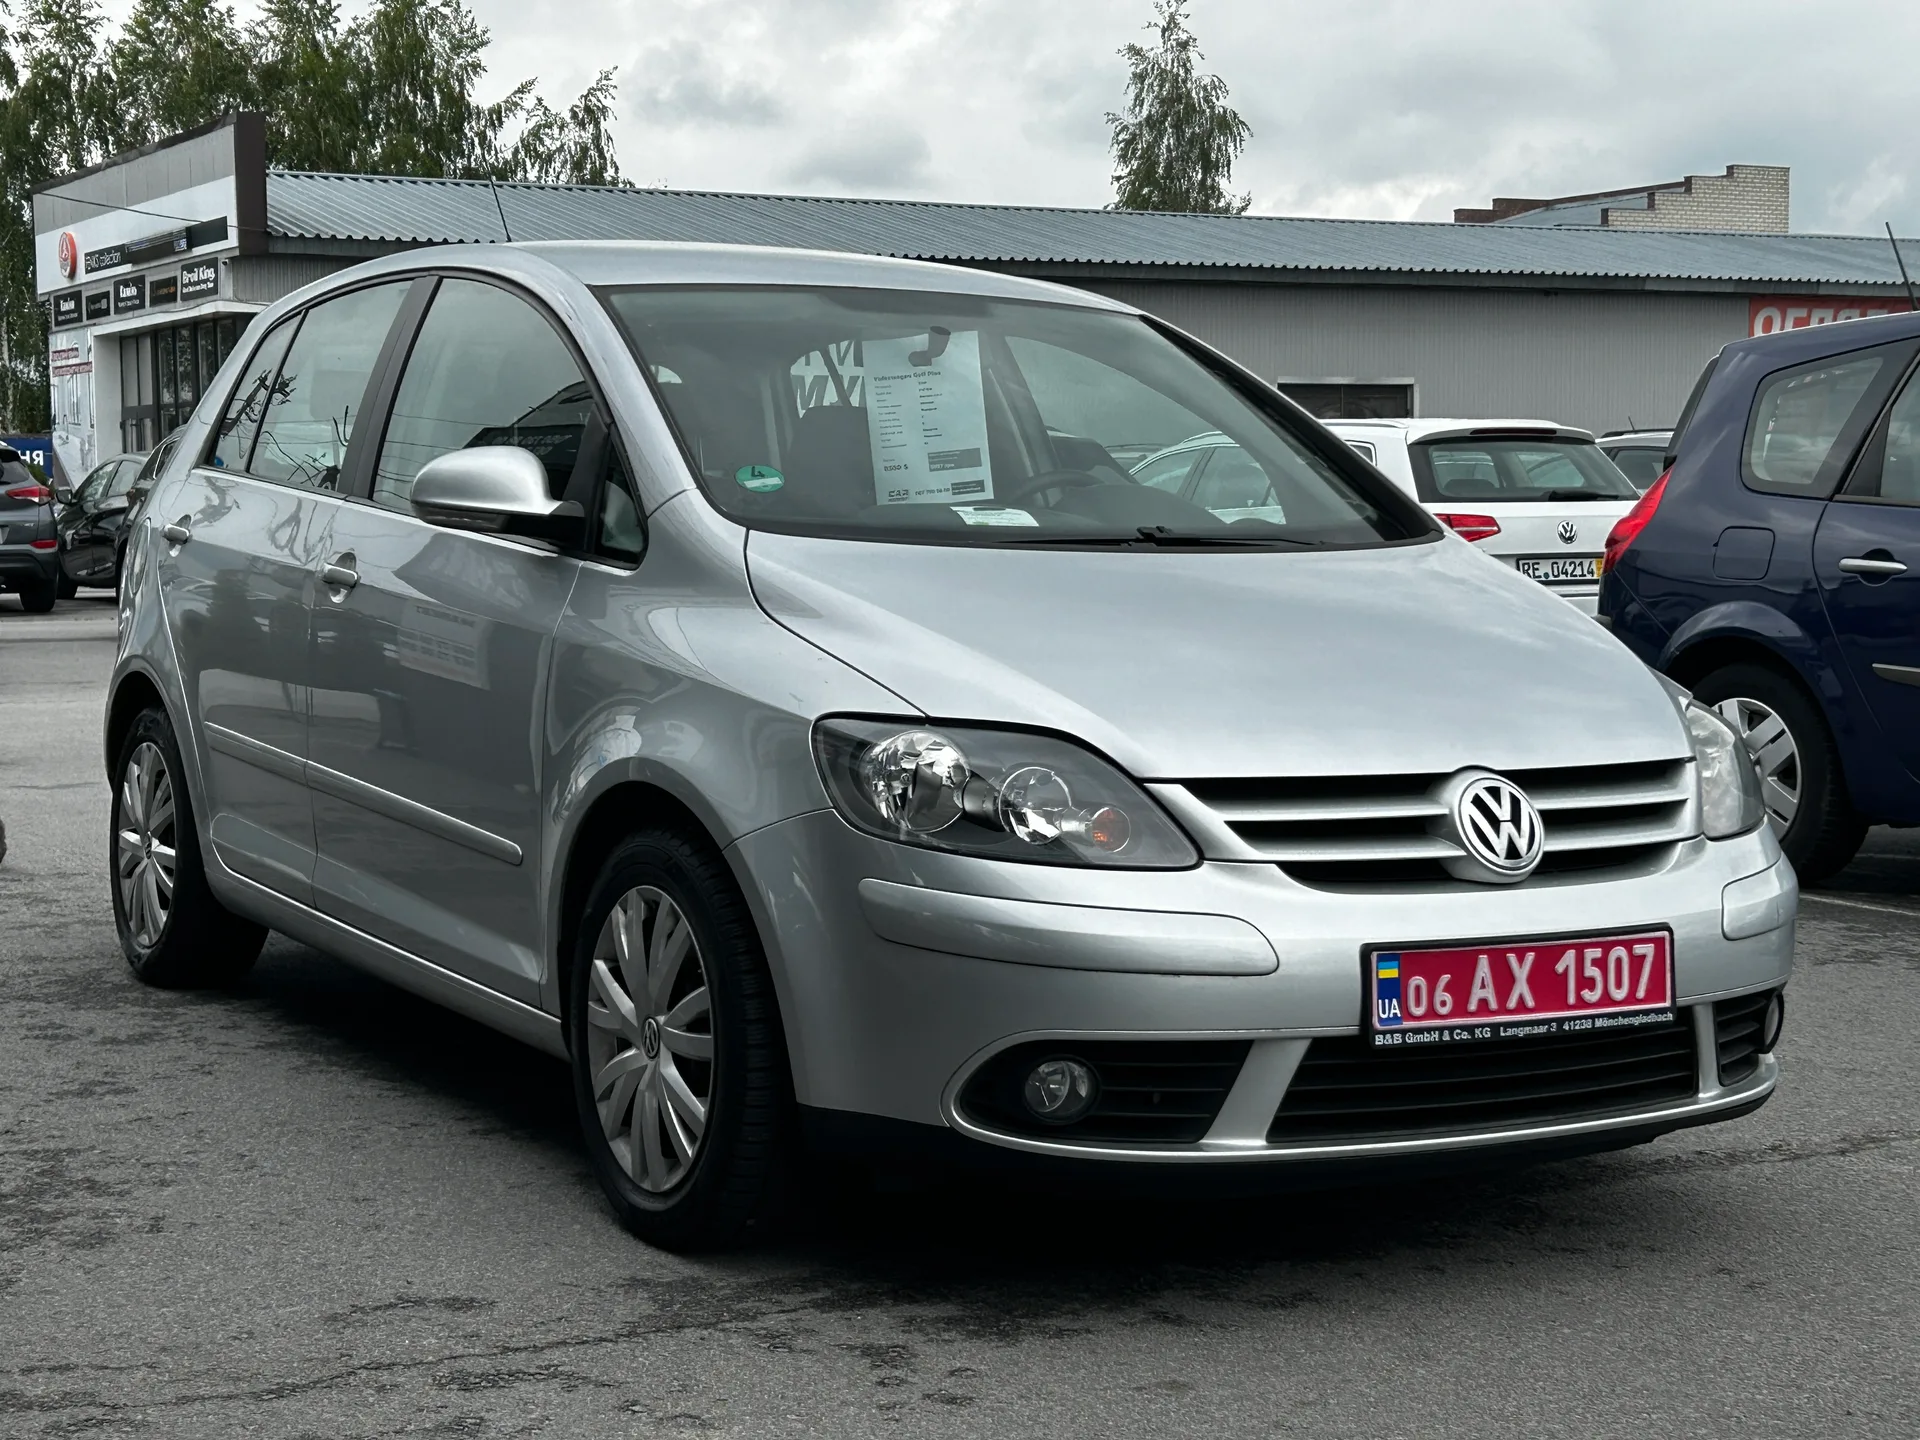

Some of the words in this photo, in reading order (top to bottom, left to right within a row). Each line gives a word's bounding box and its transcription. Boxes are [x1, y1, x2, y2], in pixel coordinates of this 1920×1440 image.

[199, 265, 215, 281] King
[1521, 561, 1542, 579] RE
[1551, 560, 1595, 578] 04214
[1407, 974, 1453, 1017] 06
[1467, 952, 1535, 1013] AX
[1554, 943, 1655, 1006] 1507
[1378, 998, 1401, 1019] UA
[1375, 1033, 1402, 1045] B&B
[1405, 1030, 1439, 1043] GmbH
[1442, 1030, 1450, 1040] &
[1453, 1029, 1471, 1040] Co.
[1474, 1027, 1491, 1038] KG
[1500, 1024, 1548, 1037] Langmaar
[1594, 1011, 1673, 1027] Mönchengladbach
